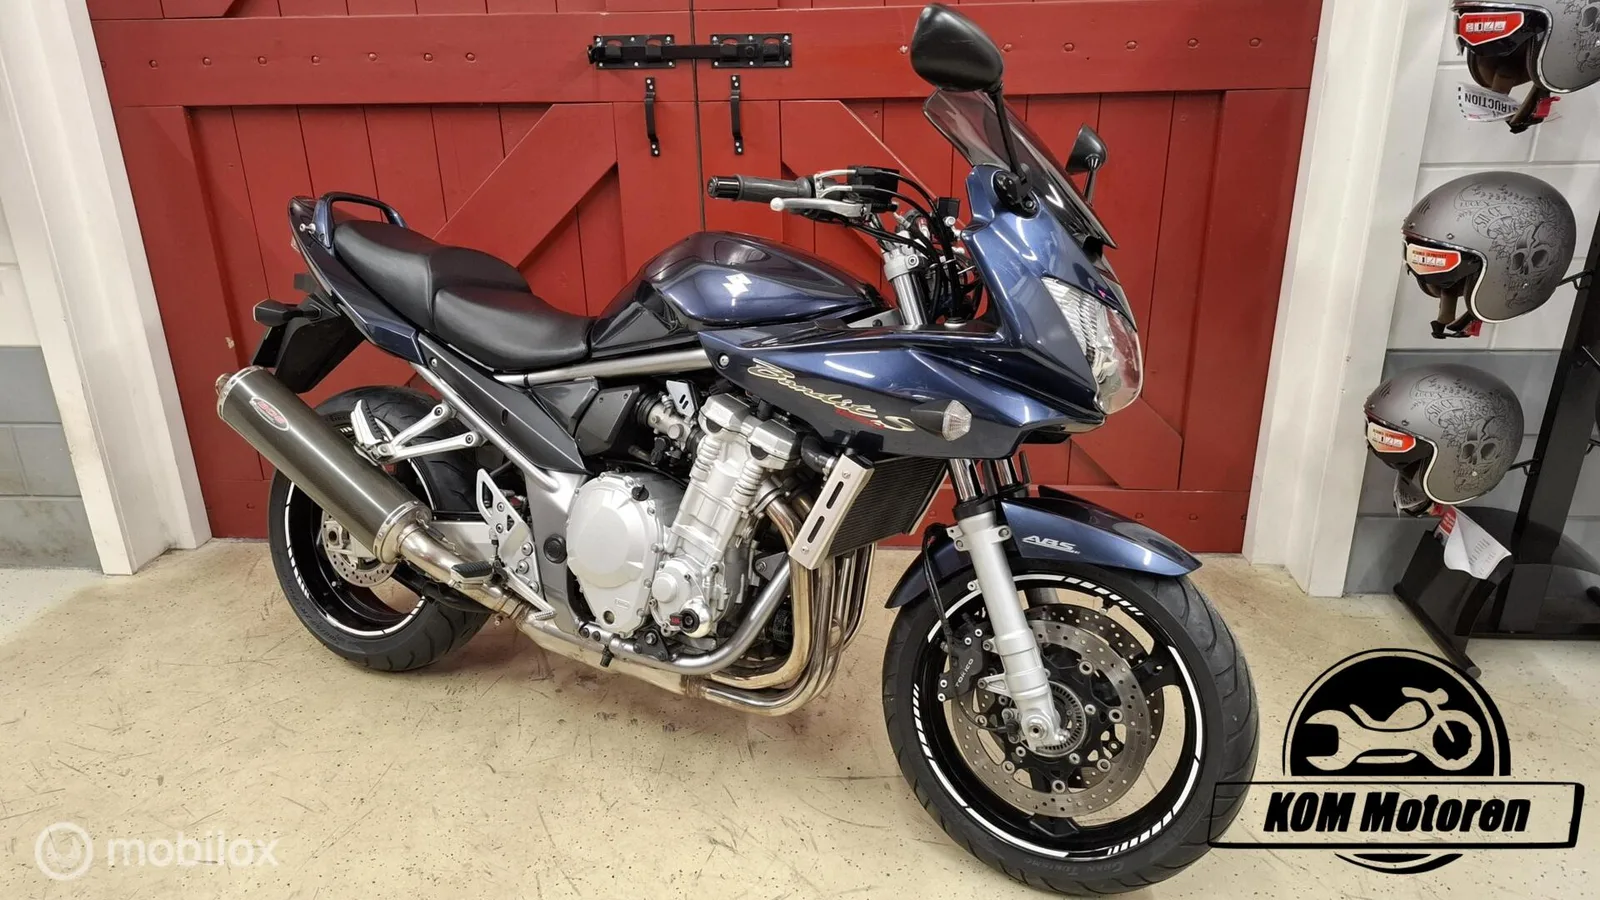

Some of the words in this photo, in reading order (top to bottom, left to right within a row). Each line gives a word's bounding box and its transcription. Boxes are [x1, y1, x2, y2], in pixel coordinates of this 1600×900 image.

[747, 357, 878, 419] Bandit
[1022, 535, 1077, 552] ABS
[955, 658, 974, 688] TOKICO
